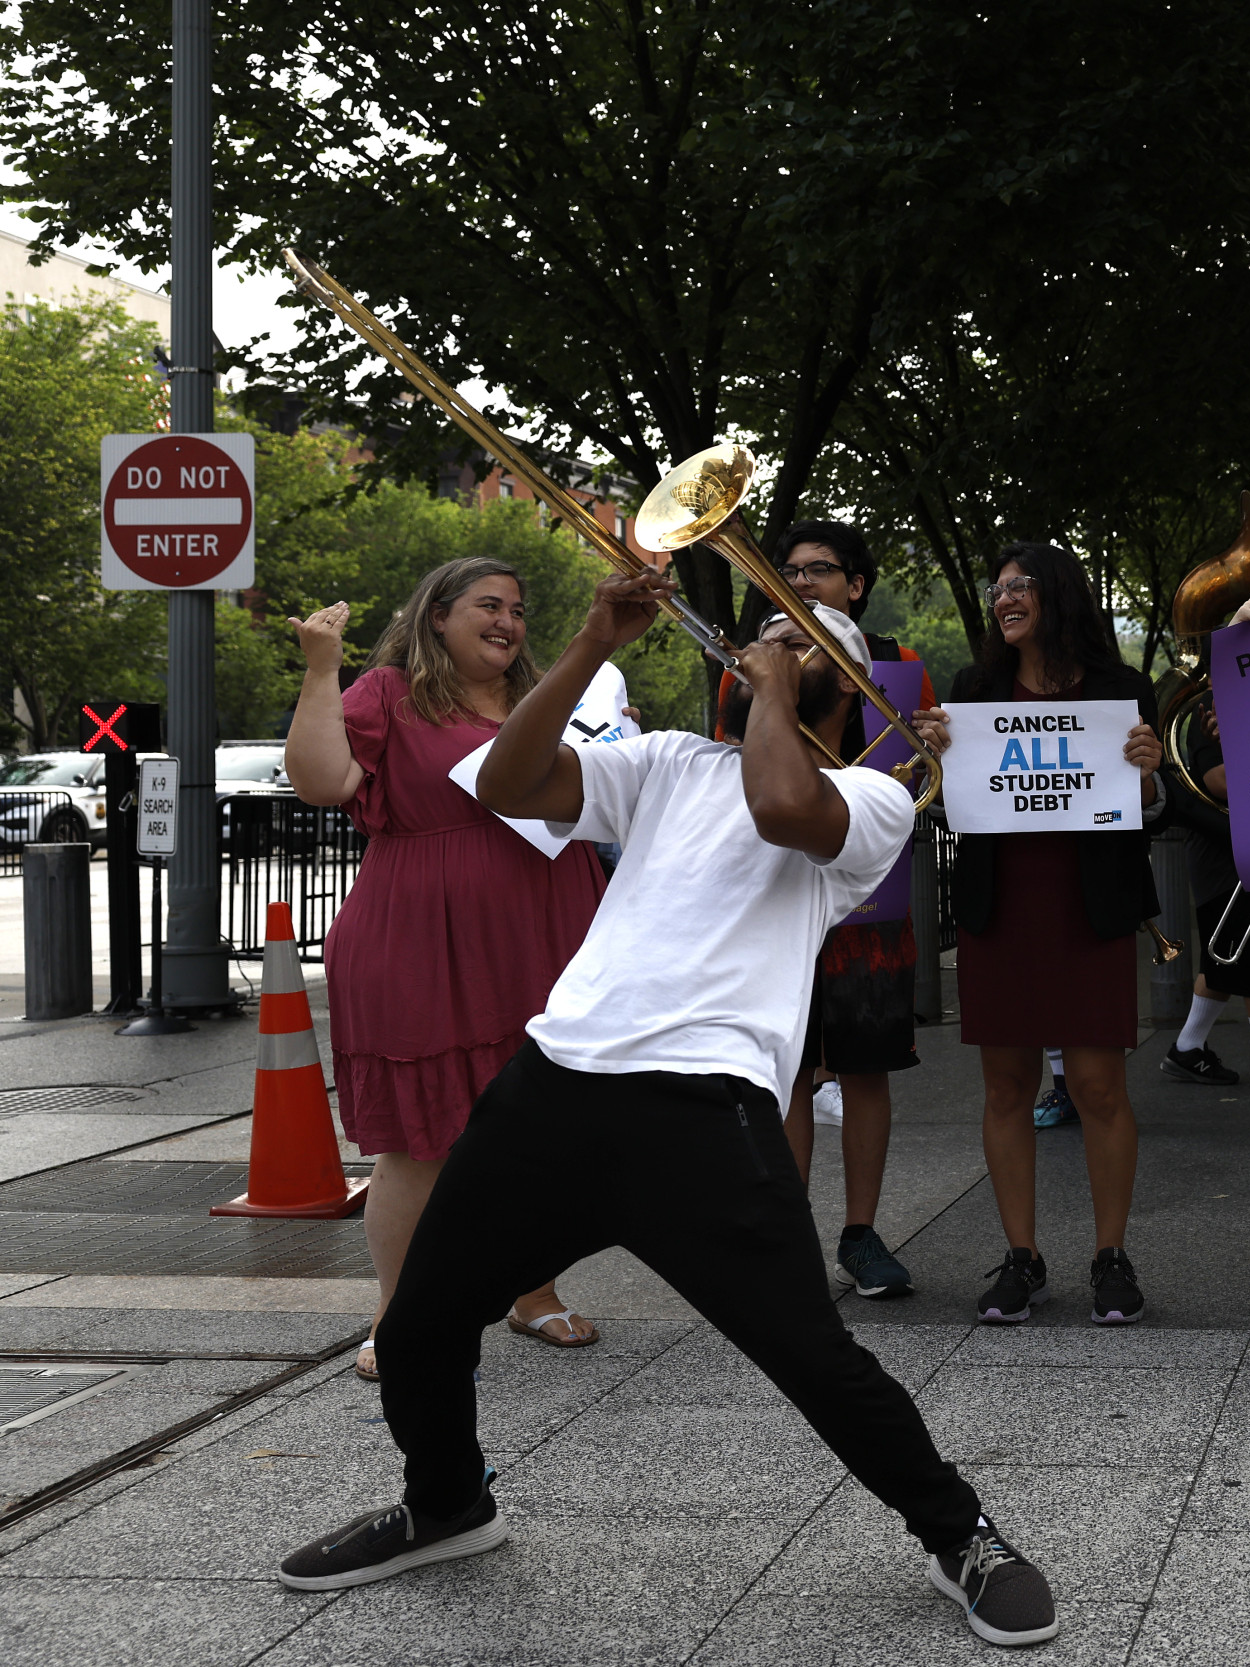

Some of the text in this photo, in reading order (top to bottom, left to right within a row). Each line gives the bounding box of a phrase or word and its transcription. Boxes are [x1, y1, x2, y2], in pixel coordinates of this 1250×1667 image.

[127, 465, 230, 490] DO NOT
[136, 533, 219, 557] ENTER
[993, 715, 1085, 733] CANCEL
[998, 736, 1084, 771] ALL
[151, 776, 166, 792] K-9
[989, 772, 1095, 792] STUDENT
[143, 798, 173, 814] SEARCH
[1014, 793, 1073, 812] DEBT
[146, 821, 168, 836] AREA
